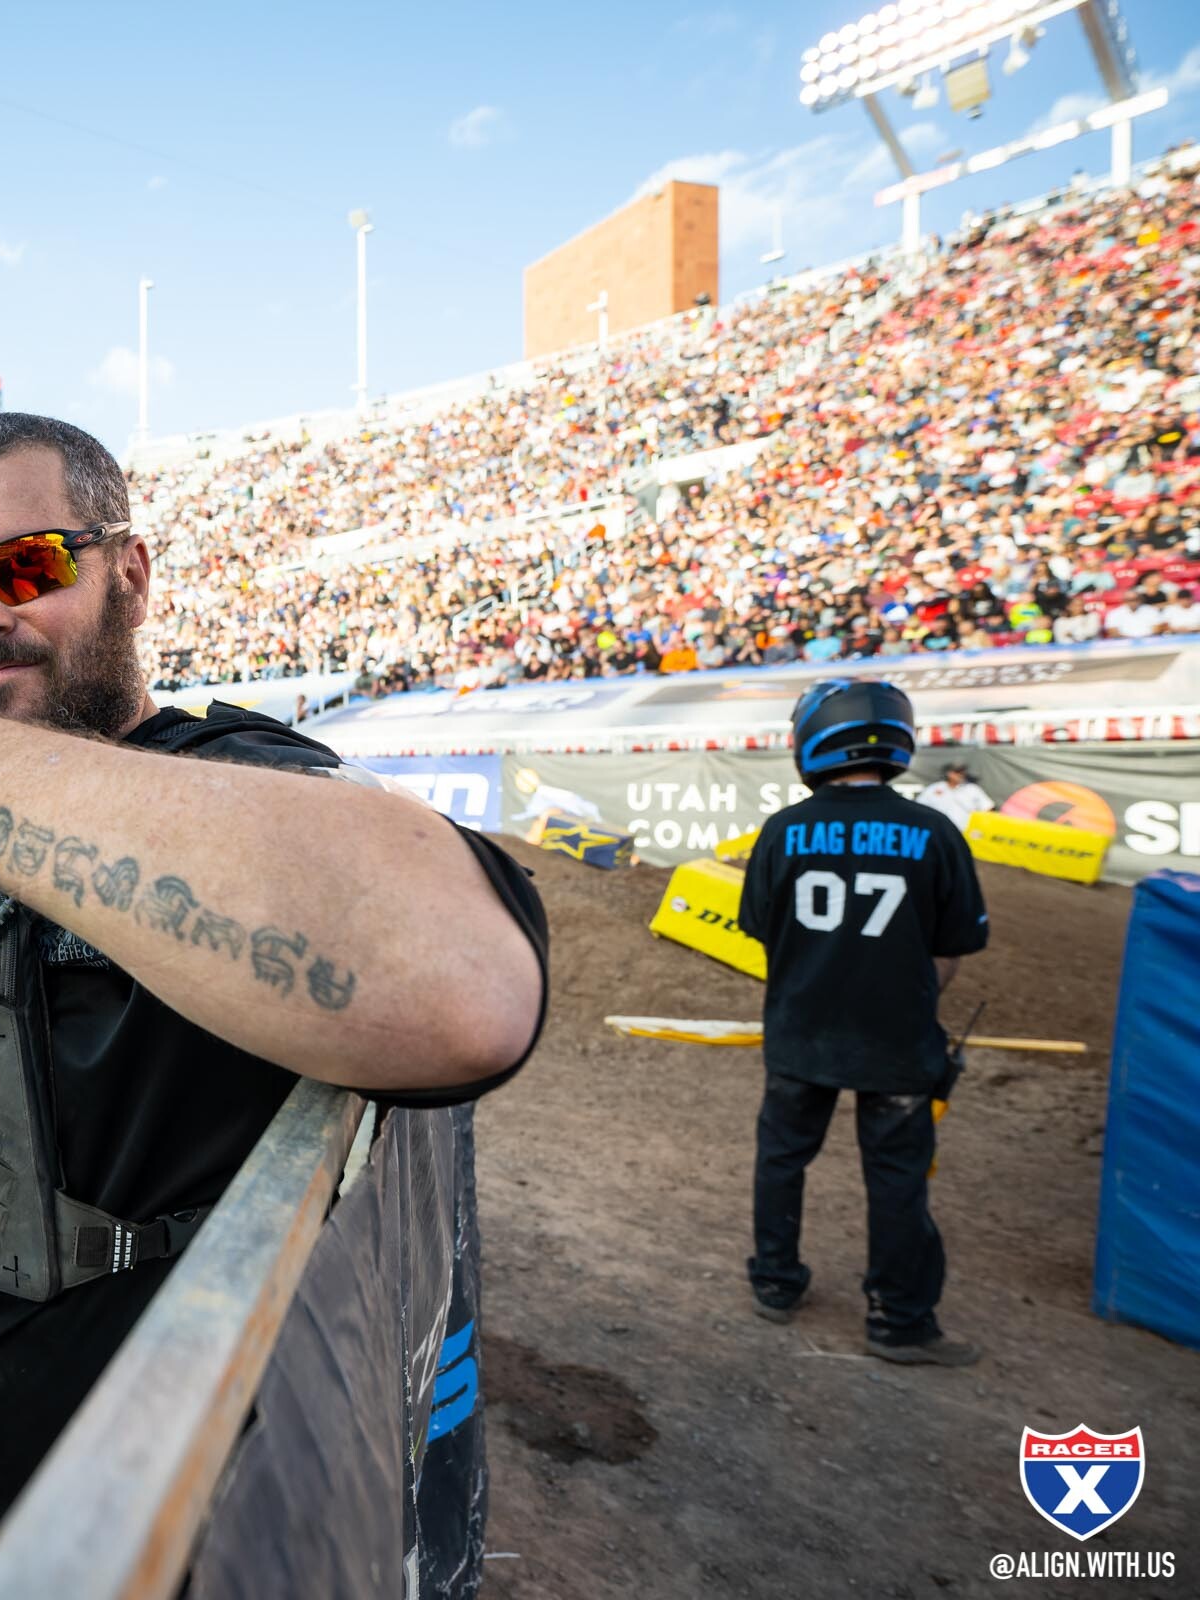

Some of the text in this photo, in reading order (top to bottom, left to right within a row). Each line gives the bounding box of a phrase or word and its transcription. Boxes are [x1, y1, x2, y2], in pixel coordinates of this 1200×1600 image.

[626, 782, 737, 813] UTAH
[784, 820, 932, 861] FLAG CREW
[794, 869, 908, 938] 07
